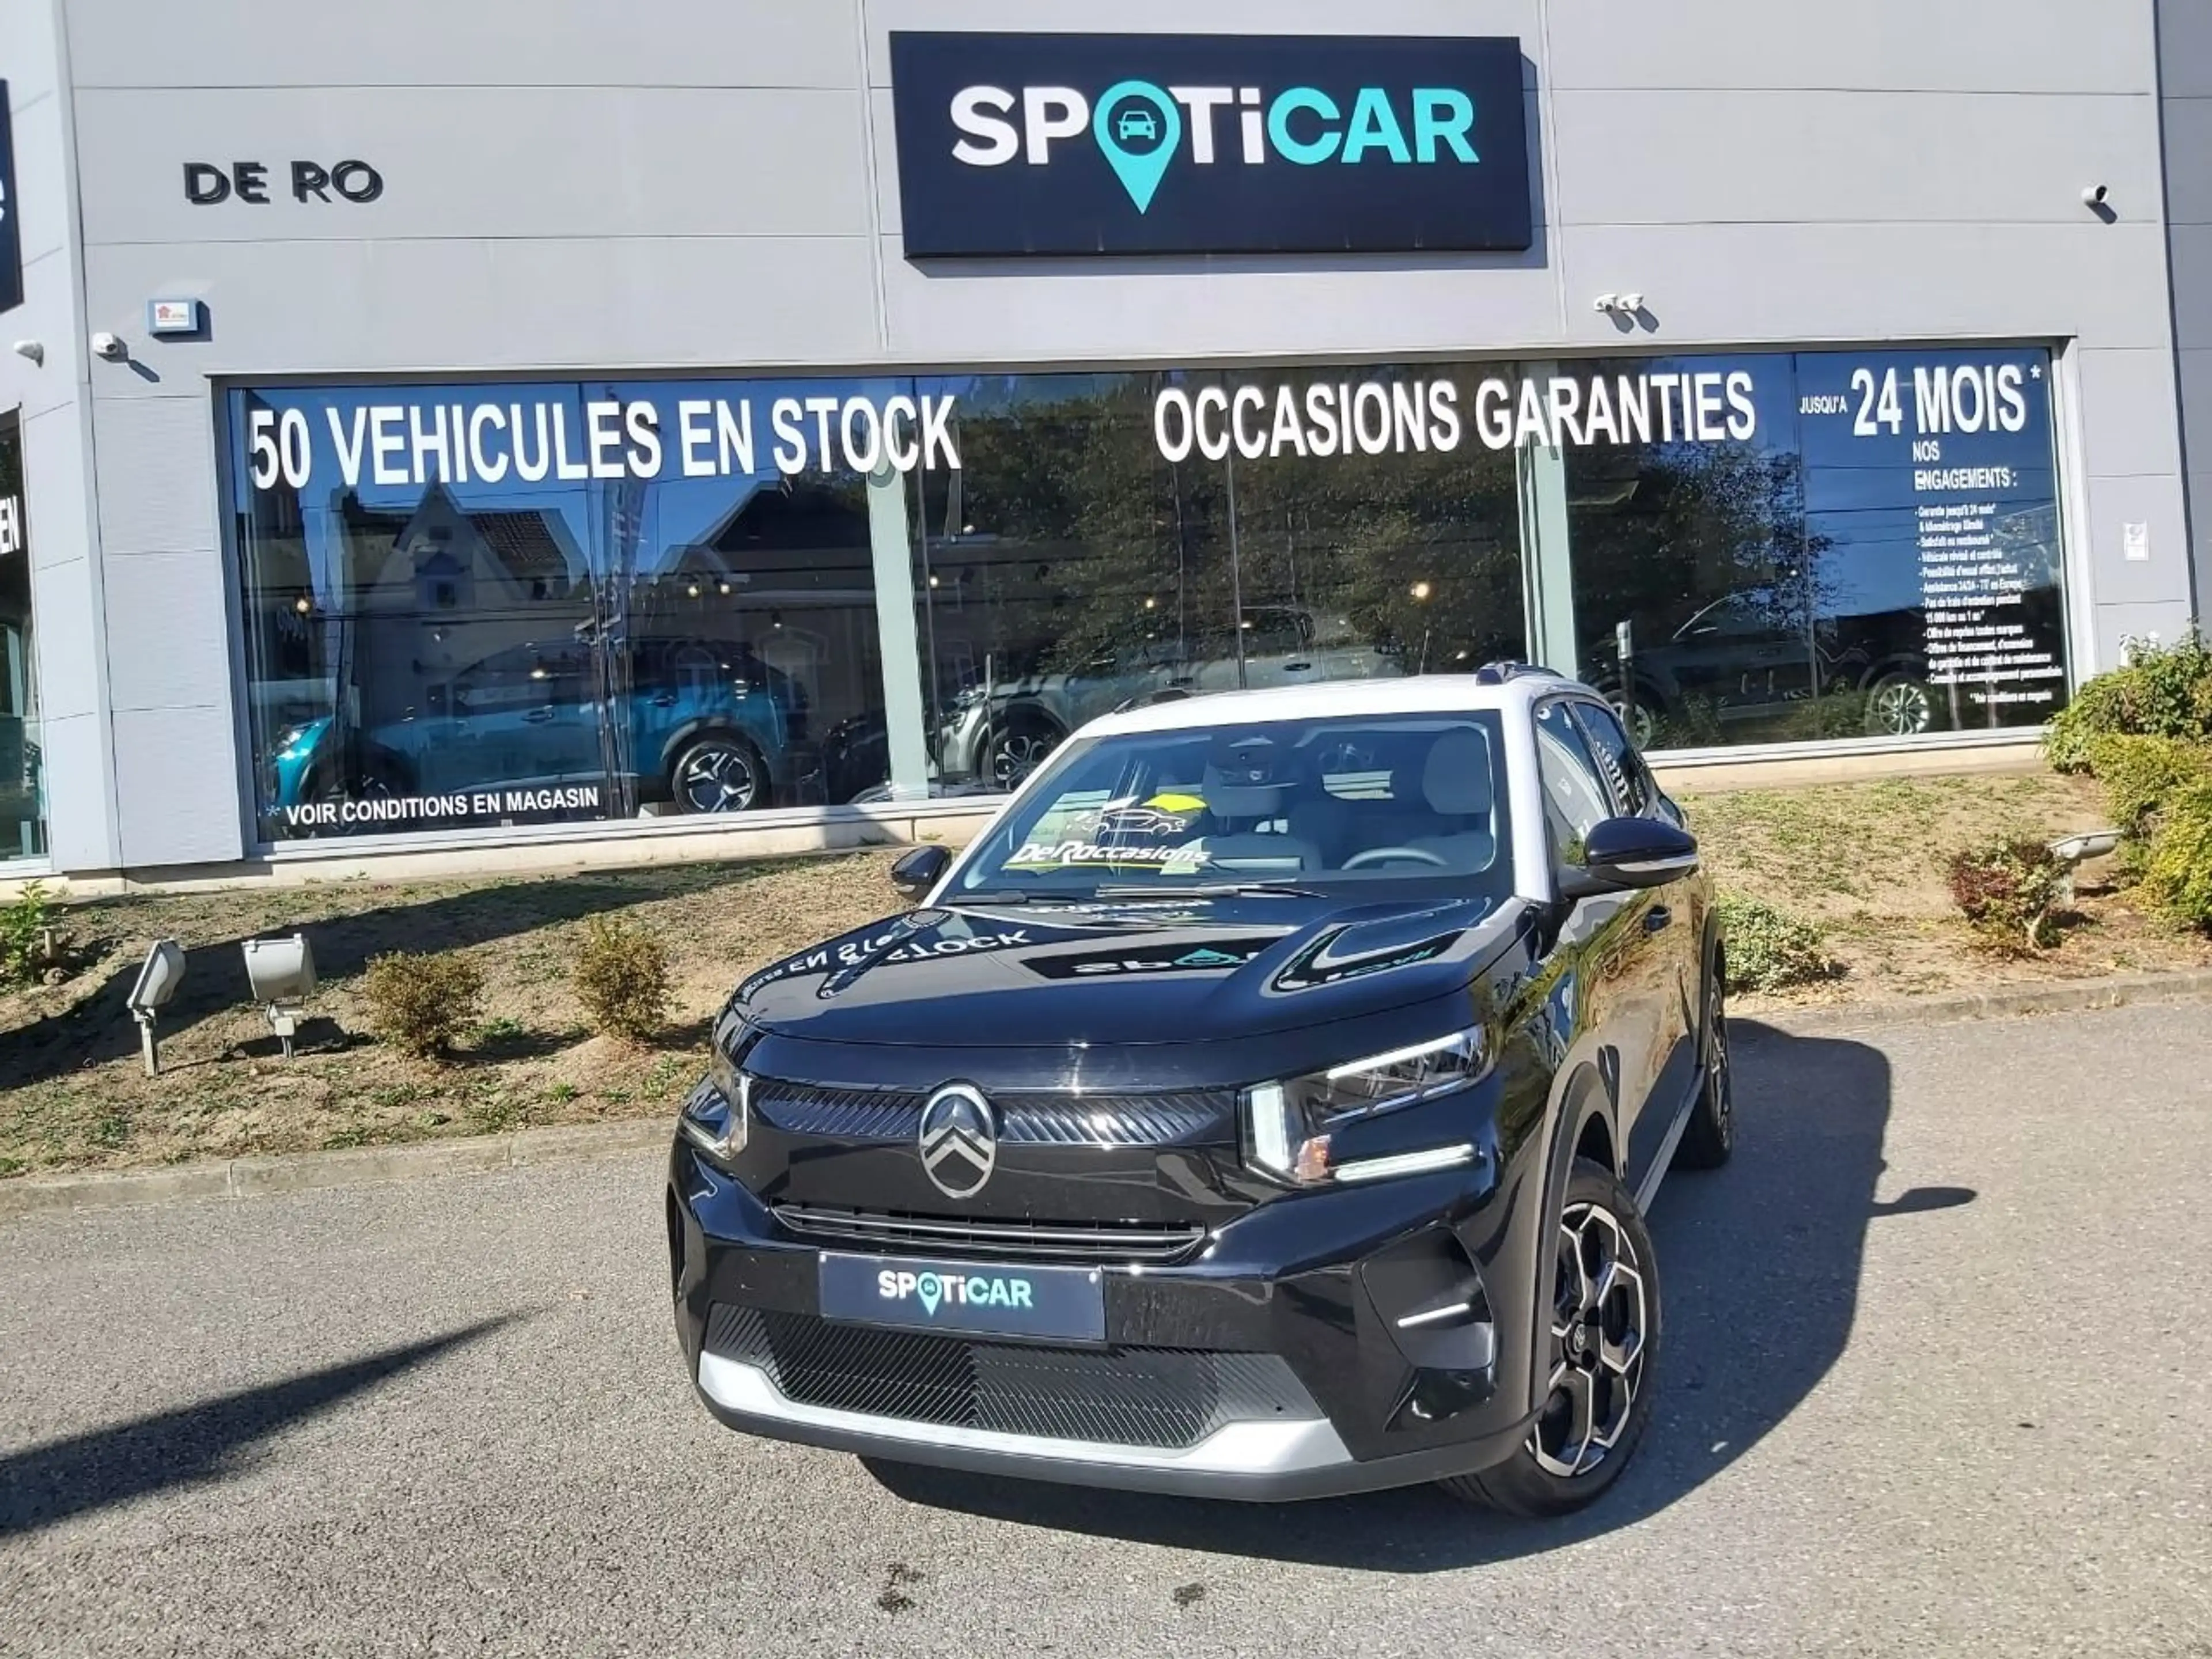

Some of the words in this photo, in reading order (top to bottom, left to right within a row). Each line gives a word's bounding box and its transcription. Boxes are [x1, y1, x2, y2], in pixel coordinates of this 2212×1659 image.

[183, 161, 270, 204] DE
[291, 160, 384, 203] RO
[1154, 378, 1460, 462] OCCASIONS
[1475, 371, 1756, 450] GARANTIES
[1851, 368, 1903, 436] 24
[249, 407, 312, 490] 50
[326, 399, 662, 486] VEHICULES
[679, 399, 755, 476] EN
[772, 395, 961, 475] STOCK
[1913, 441, 1940, 461] NOS
[1914, 467, 2010, 490] ENGAGEMENTS
[287, 804, 336, 825] VOIR
[342, 796, 468, 822] CONDITIONS
[472, 793, 501, 814] EN
[505, 787, 599, 812] MAGASIN
